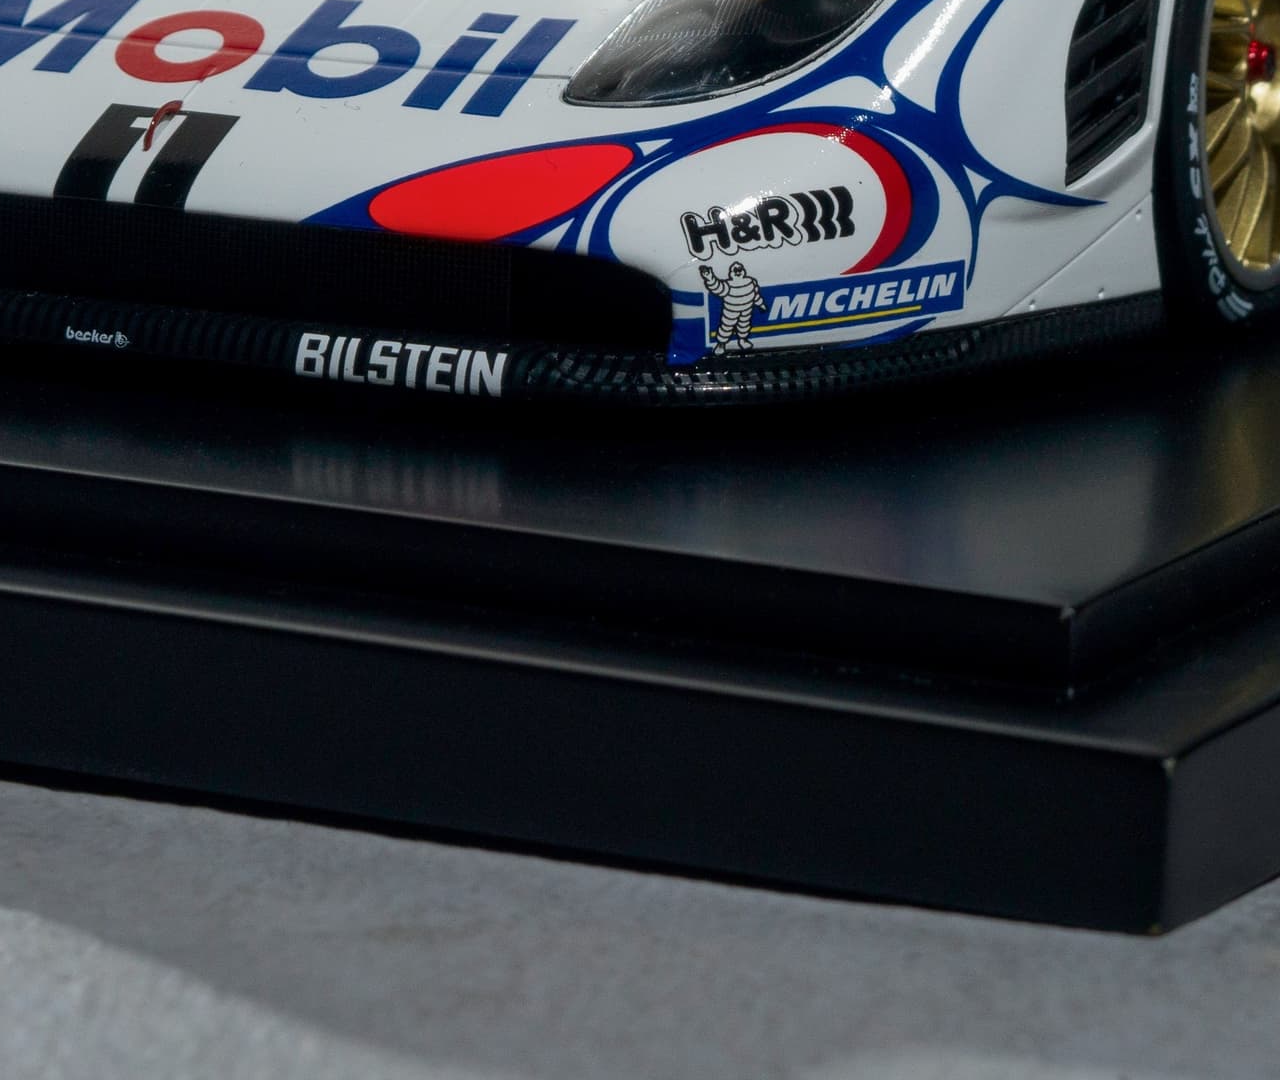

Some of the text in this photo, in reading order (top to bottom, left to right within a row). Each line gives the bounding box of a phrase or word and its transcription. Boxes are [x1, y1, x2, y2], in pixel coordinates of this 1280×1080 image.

[680, 194, 803, 261] H&R
[767, 272, 958, 321] MICHELIN
[65, 325, 114, 345] becker
[294, 331, 509, 398] BILSTEIN
